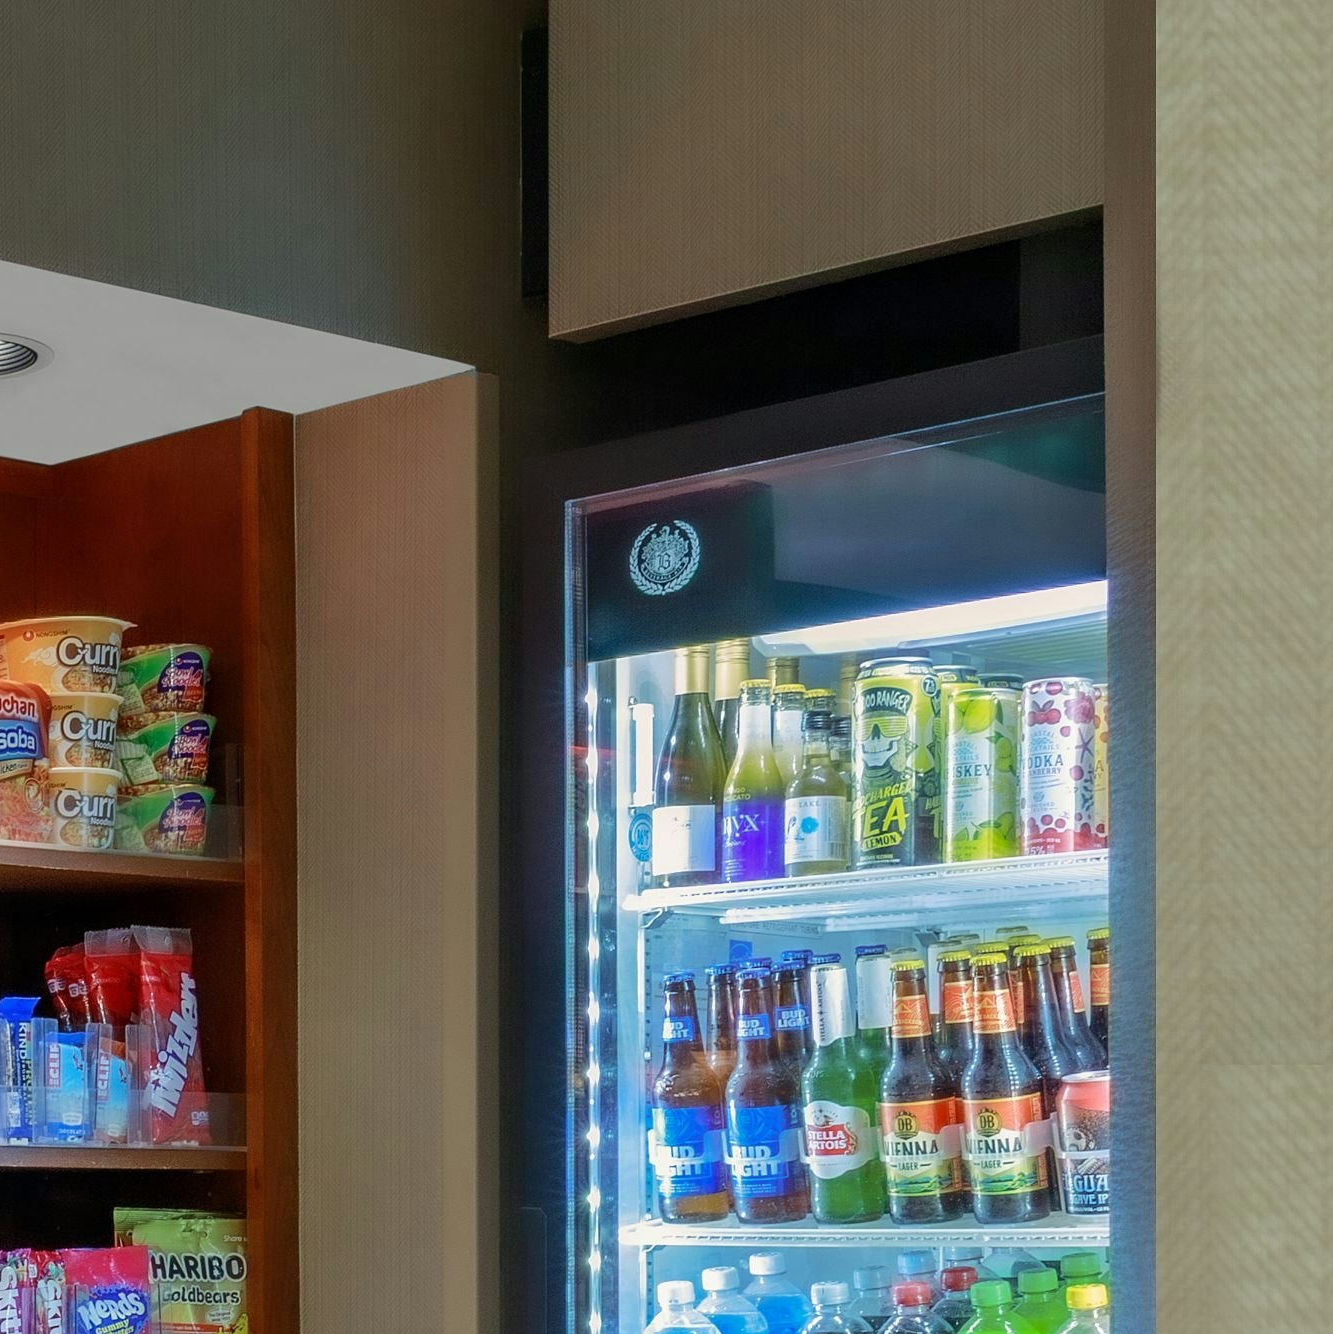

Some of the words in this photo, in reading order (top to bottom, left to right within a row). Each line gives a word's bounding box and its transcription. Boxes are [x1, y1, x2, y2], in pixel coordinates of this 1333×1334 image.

[864, 834, 898, 849] LEMON
[781, 1008, 806, 1020] BUD
[777, 1016, 810, 1029] LIGHT
[807, 1130, 846, 1141] STELLA
[808, 1138, 847, 1150] ARTOIS
[897, 1161, 919, 1171] LAGER
[980, 1159, 1002, 1169] LAGER
[150, 1253, 246, 1282] HARIBO
[161, 1286, 241, 1304] Goldbears
